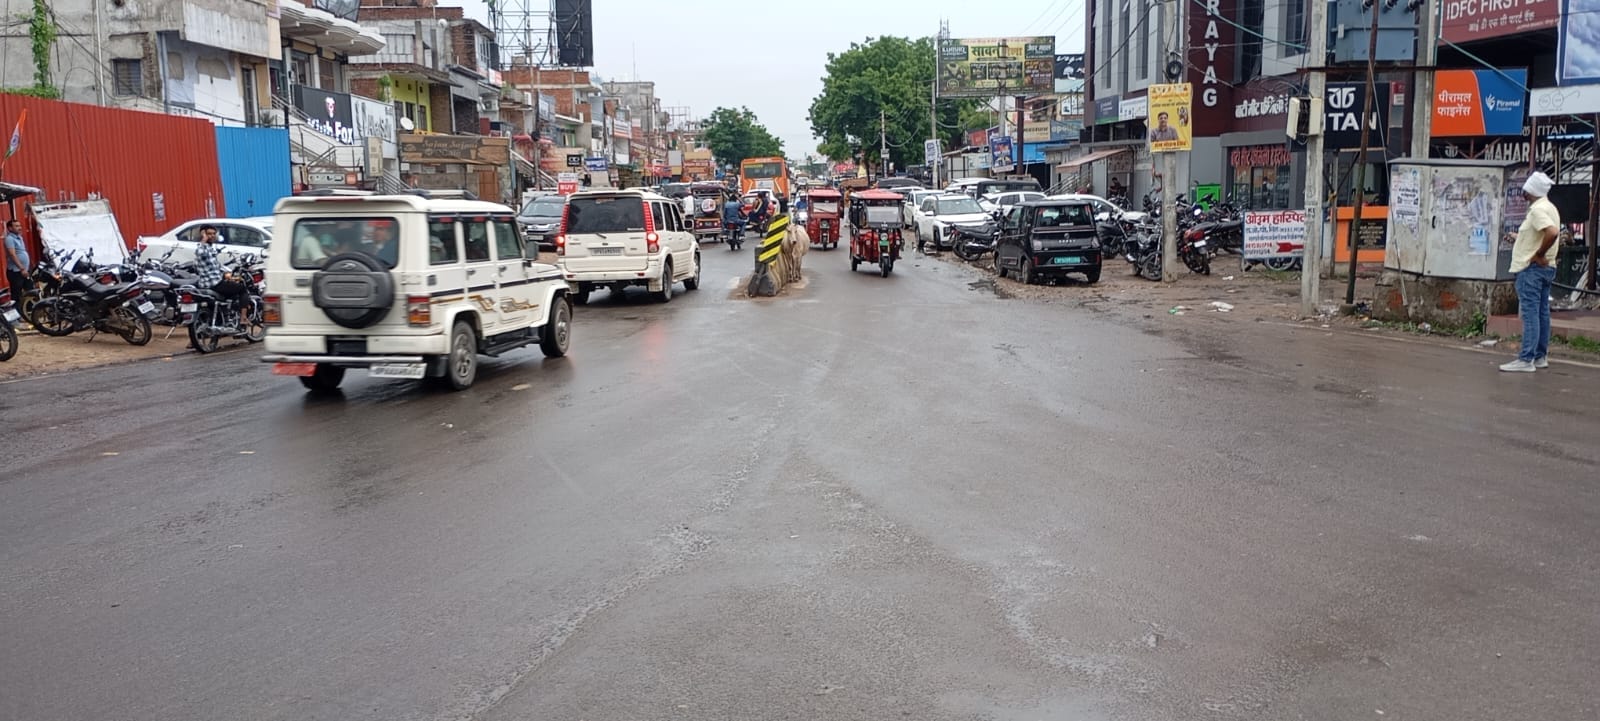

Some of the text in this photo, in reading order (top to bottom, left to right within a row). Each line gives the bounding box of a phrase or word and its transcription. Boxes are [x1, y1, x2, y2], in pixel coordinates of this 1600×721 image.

[1446, 0, 1477, 20] IDFC
[1438, 89, 1472, 103] पीरामल
[334, 121, 353, 146] Fox
